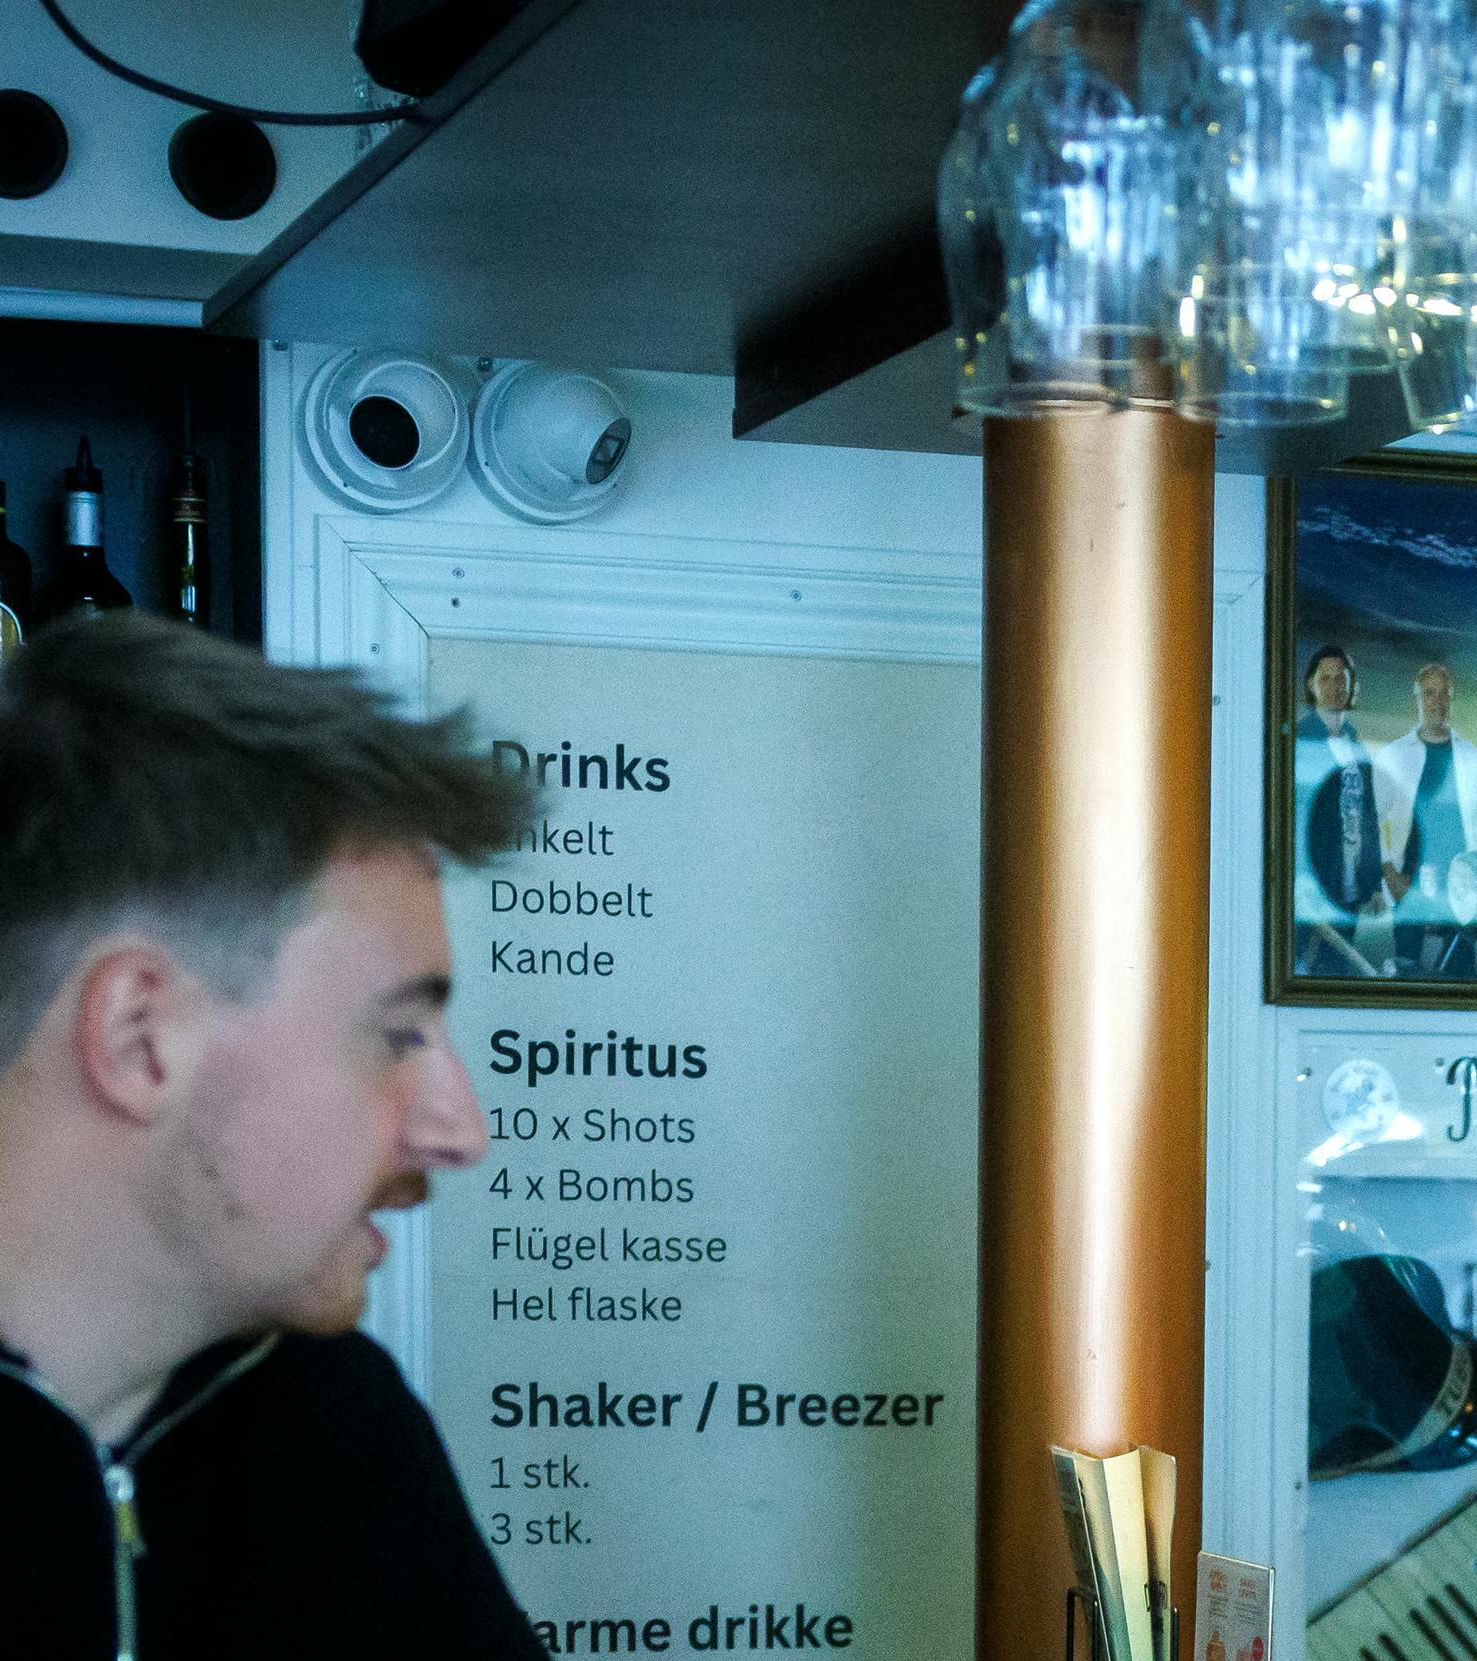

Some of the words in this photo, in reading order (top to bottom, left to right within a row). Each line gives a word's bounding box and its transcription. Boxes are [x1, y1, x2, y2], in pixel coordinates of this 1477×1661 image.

[491, 739, 672, 793] Drinks
[509, 819, 615, 856] nkelt
[490, 880, 654, 918] Dobbelt
[490, 941, 615, 977] Kande
[489, 1028, 709, 1089] Spiritus
[489, 1107, 539, 1142] 10
[552, 1117, 571, 1141] x
[583, 1108, 697, 1145] Shots
[489, 1167, 513, 1200] 4
[525, 1177, 545, 1200] x
[558, 1168, 695, 1204] Bombs
[491, 1226, 608, 1271] Flügel
[621, 1229, 729, 1264] kasse
[491, 1288, 557, 1322] Hel
[568, 1286, 684, 1323] flaske
[490, 1380, 683, 1429] Shaker
[695, 1380, 719, 1434] /
[736, 1382, 945, 1429] Breezer
[490, 1458, 511, 1489] 1
[523, 1455, 591, 1489] stk.
[489, 1513, 513, 1546] 3
[525, 1511, 593, 1546] stk.
[528, 1615, 673, 1654] arme
[687, 1602, 855, 1652] drikke
